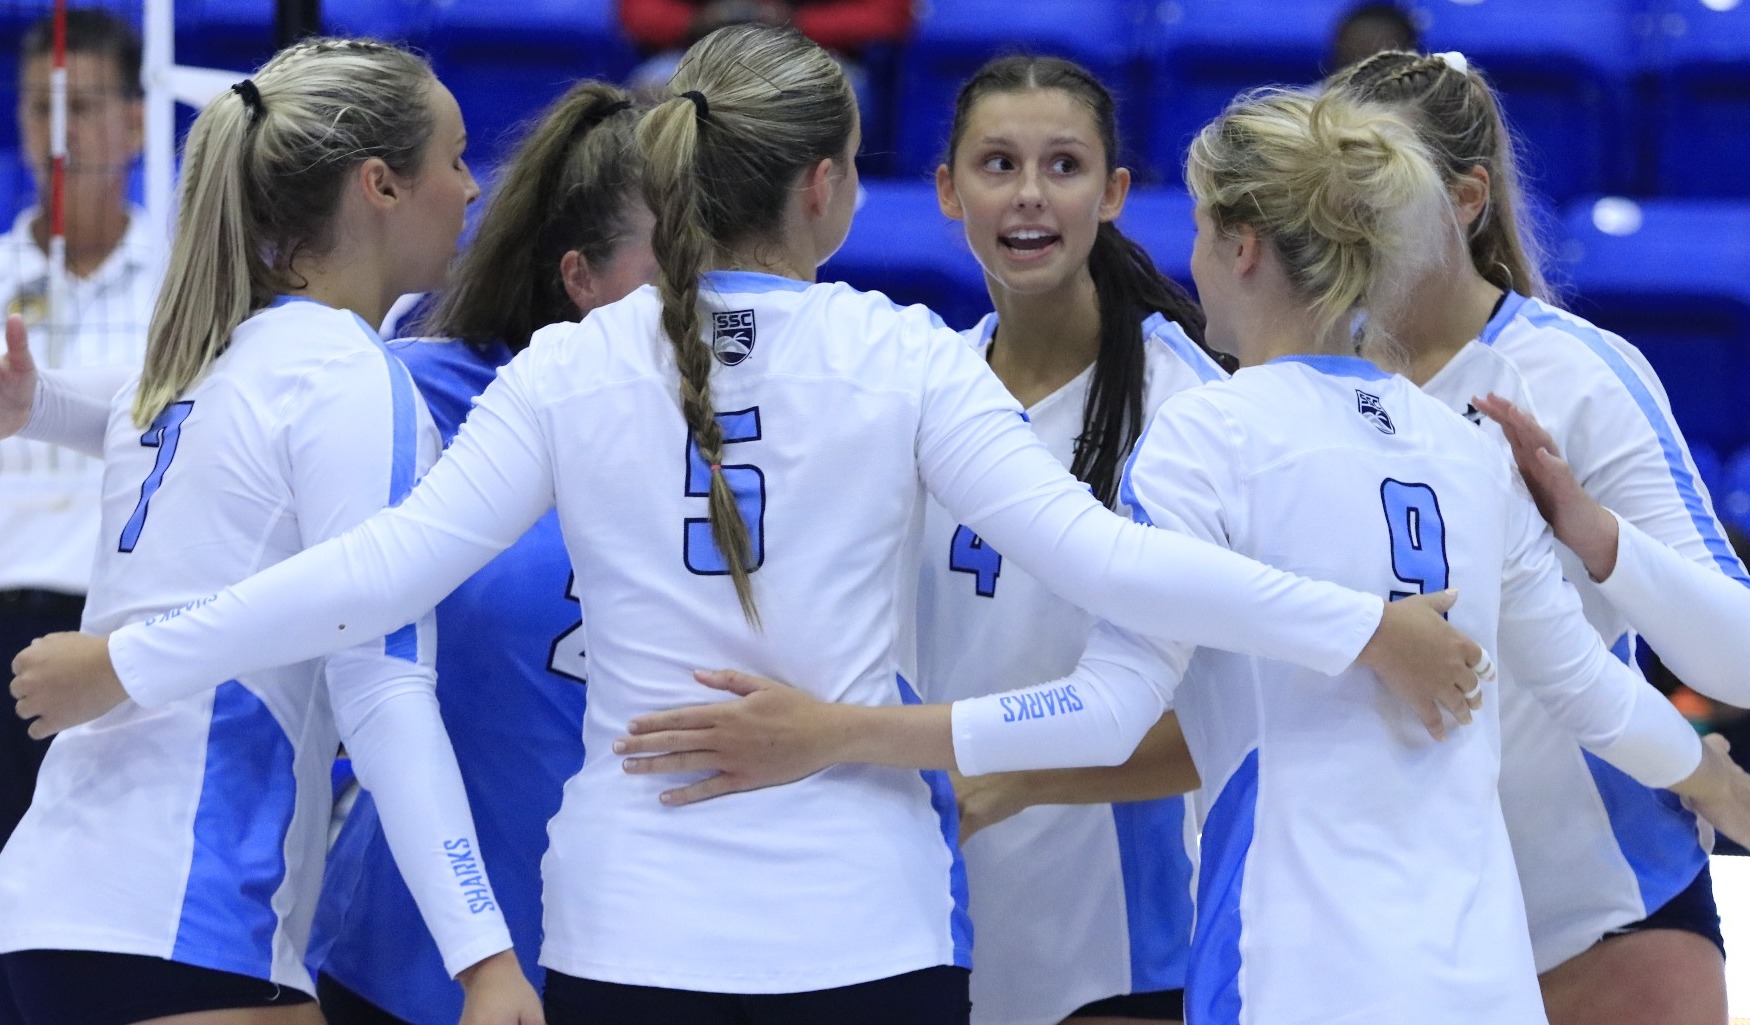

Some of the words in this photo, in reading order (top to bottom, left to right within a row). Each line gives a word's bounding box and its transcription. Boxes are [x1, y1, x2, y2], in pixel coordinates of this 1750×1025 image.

[716, 313, 752, 328] SSC
[118, 400, 195, 553] 7
[684, 406, 766, 575] 5
[949, 524, 1003, 598] 4
[1379, 477, 1449, 621] 9
[999, 684, 1084, 722] SHARKS
[443, 838, 495, 914] SHARKS
